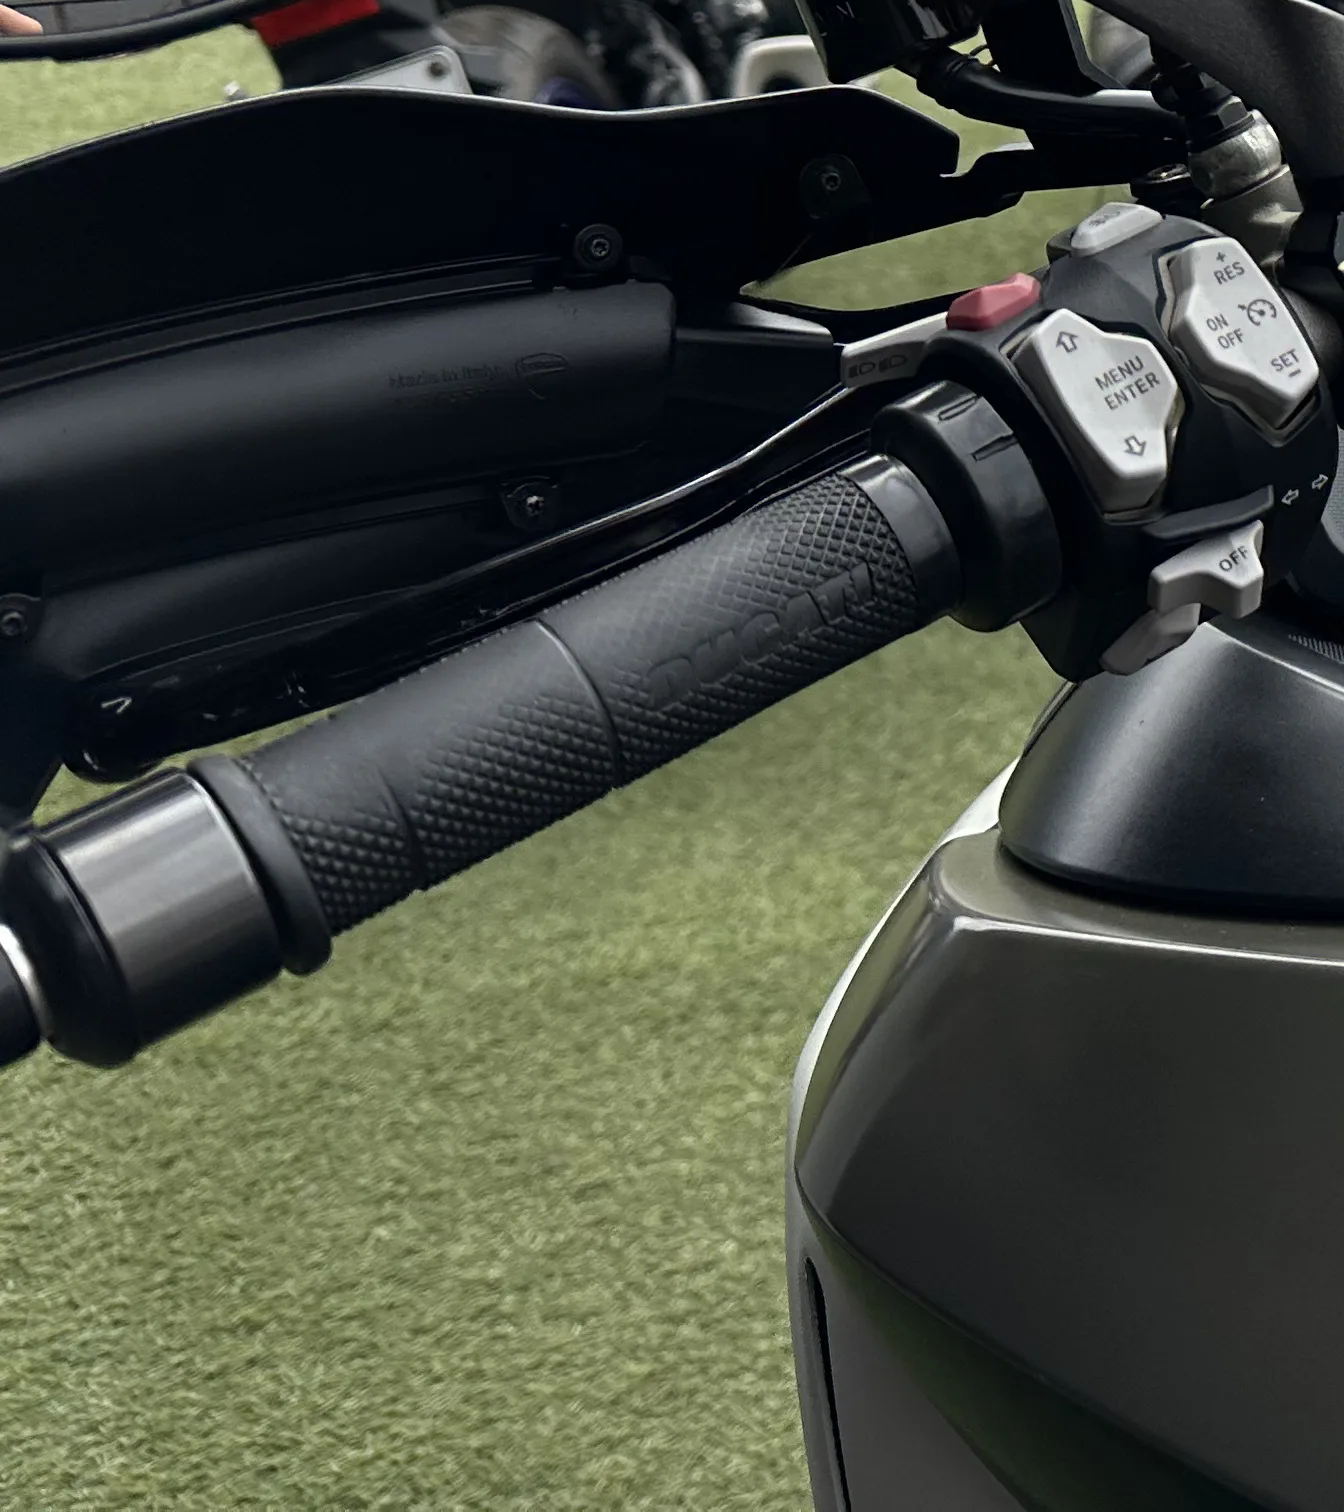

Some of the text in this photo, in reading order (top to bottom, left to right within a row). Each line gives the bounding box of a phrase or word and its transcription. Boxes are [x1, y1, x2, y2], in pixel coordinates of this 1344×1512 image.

[1213, 261, 1246, 287] RES
[1206, 313, 1229, 333] ON
[1216, 327, 1245, 351] OFF
[1094, 355, 1146, 392] MENU
[1270, 348, 1300, 374] SET
[1105, 371, 1161, 412] ENTER
[1218, 544, 1250, 574] OFF
[647, 560, 876, 708] DUCATI
